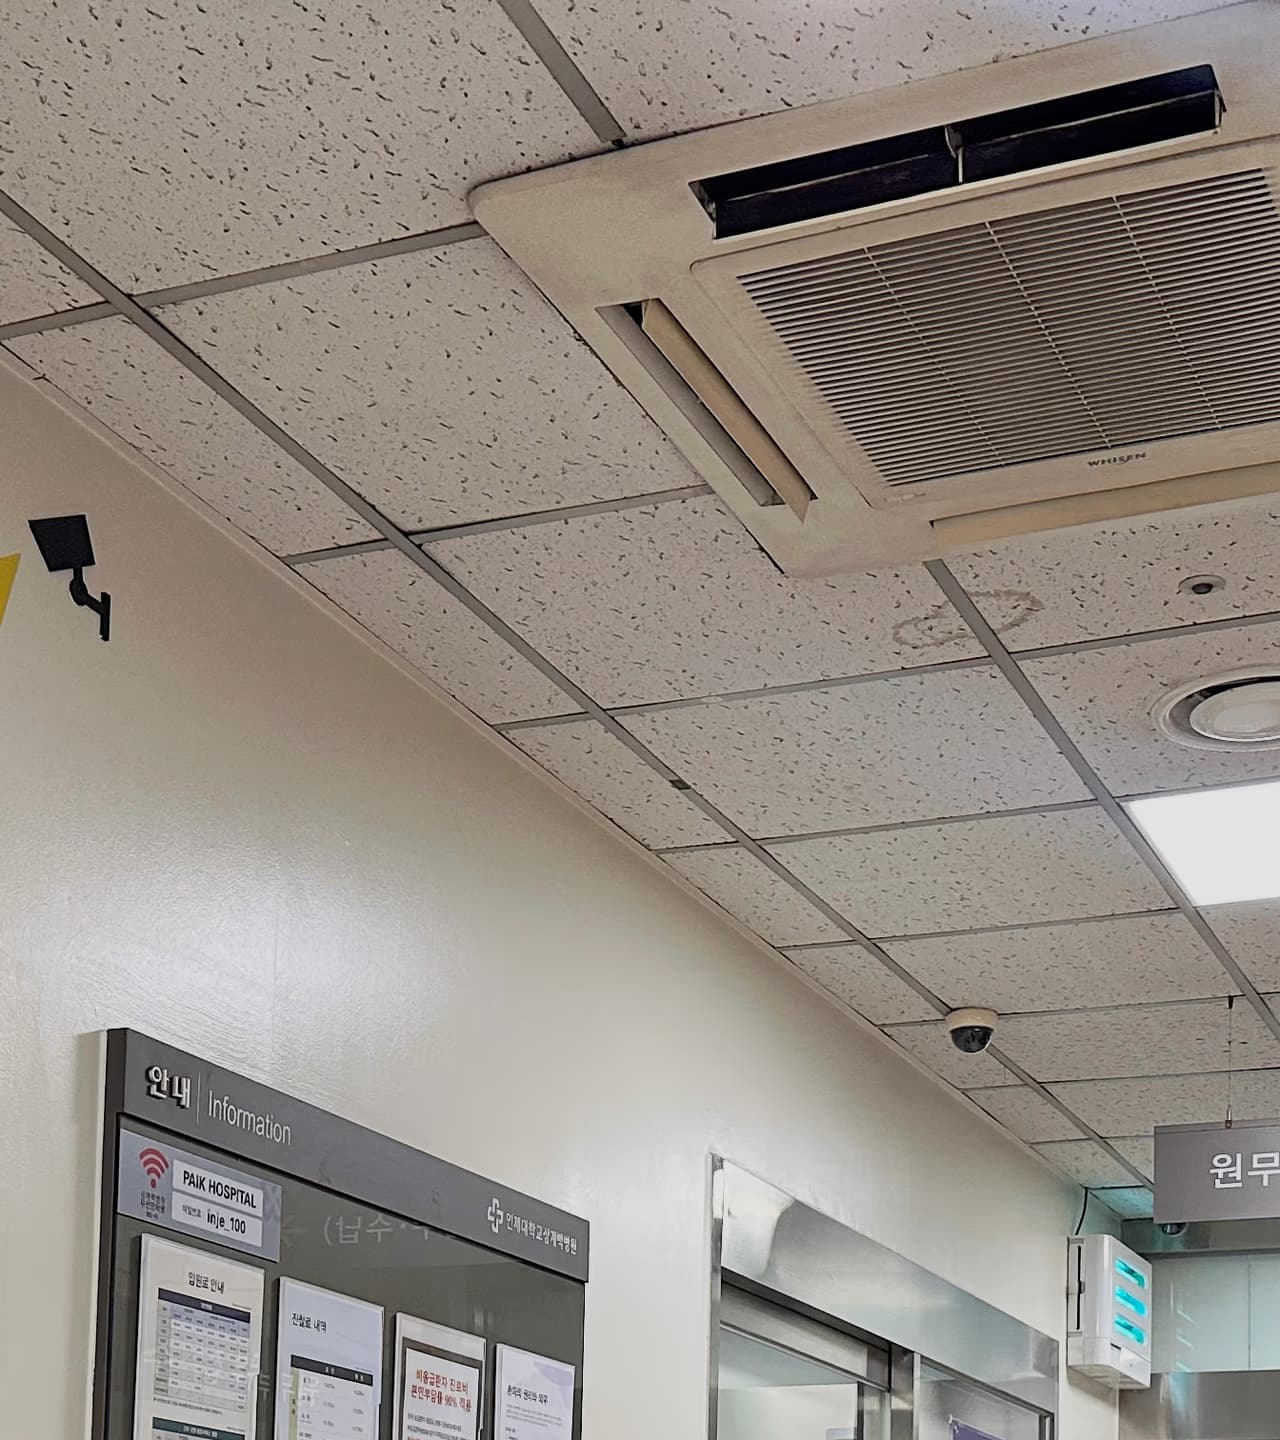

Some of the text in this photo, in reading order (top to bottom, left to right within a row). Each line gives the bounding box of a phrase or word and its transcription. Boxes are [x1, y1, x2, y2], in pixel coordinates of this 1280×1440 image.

[1088, 452, 1147, 467] WHISEN
[146, 1066, 191, 1108] 안내
[208, 1090, 292, 1145] Information
[183, 1170, 257, 1209] PAIK HOSPITAL
[207, 1209, 246, 1235] inje_100
[450, 1379, 468, 1394] 진료비
